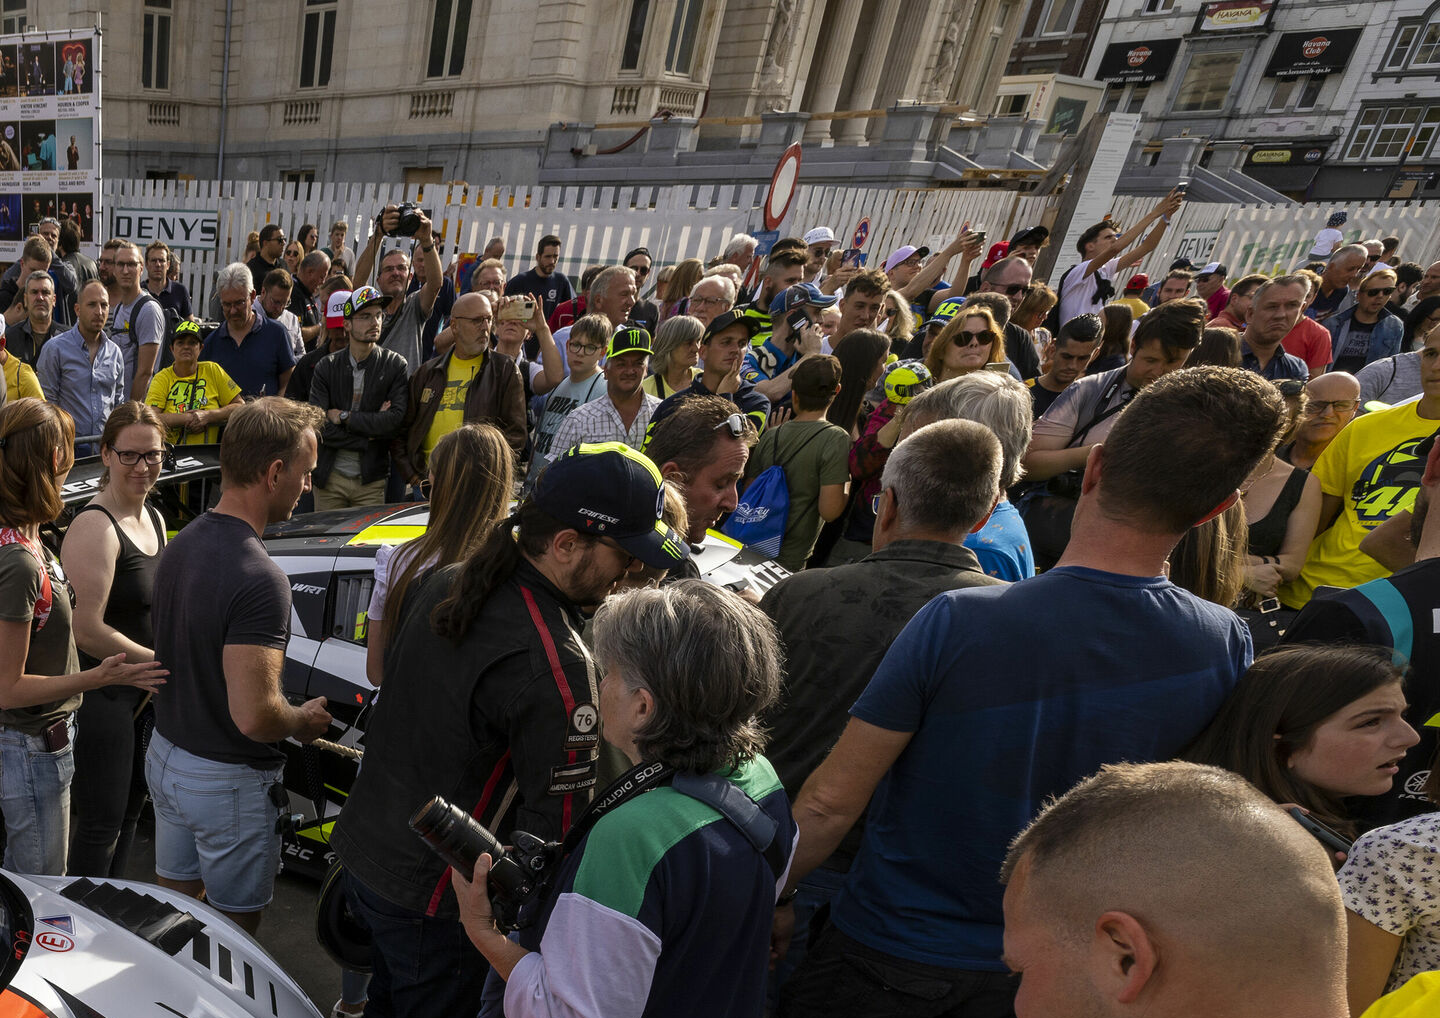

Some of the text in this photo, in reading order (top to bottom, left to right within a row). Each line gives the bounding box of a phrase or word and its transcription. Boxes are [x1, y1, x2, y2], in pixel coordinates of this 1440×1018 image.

[1303, 39, 1331, 49] Havana
[1127, 49, 1153, 58] Havana
[1304, 47, 1322, 57] Club
[1129, 55, 1145, 65] Club
[116, 215, 218, 242] DENYS
[176, 321, 200, 333] 46
[291, 582, 326, 596] WRT
[576, 713, 593, 727] 76
[591, 762, 664, 815] EOS DIGITAL
